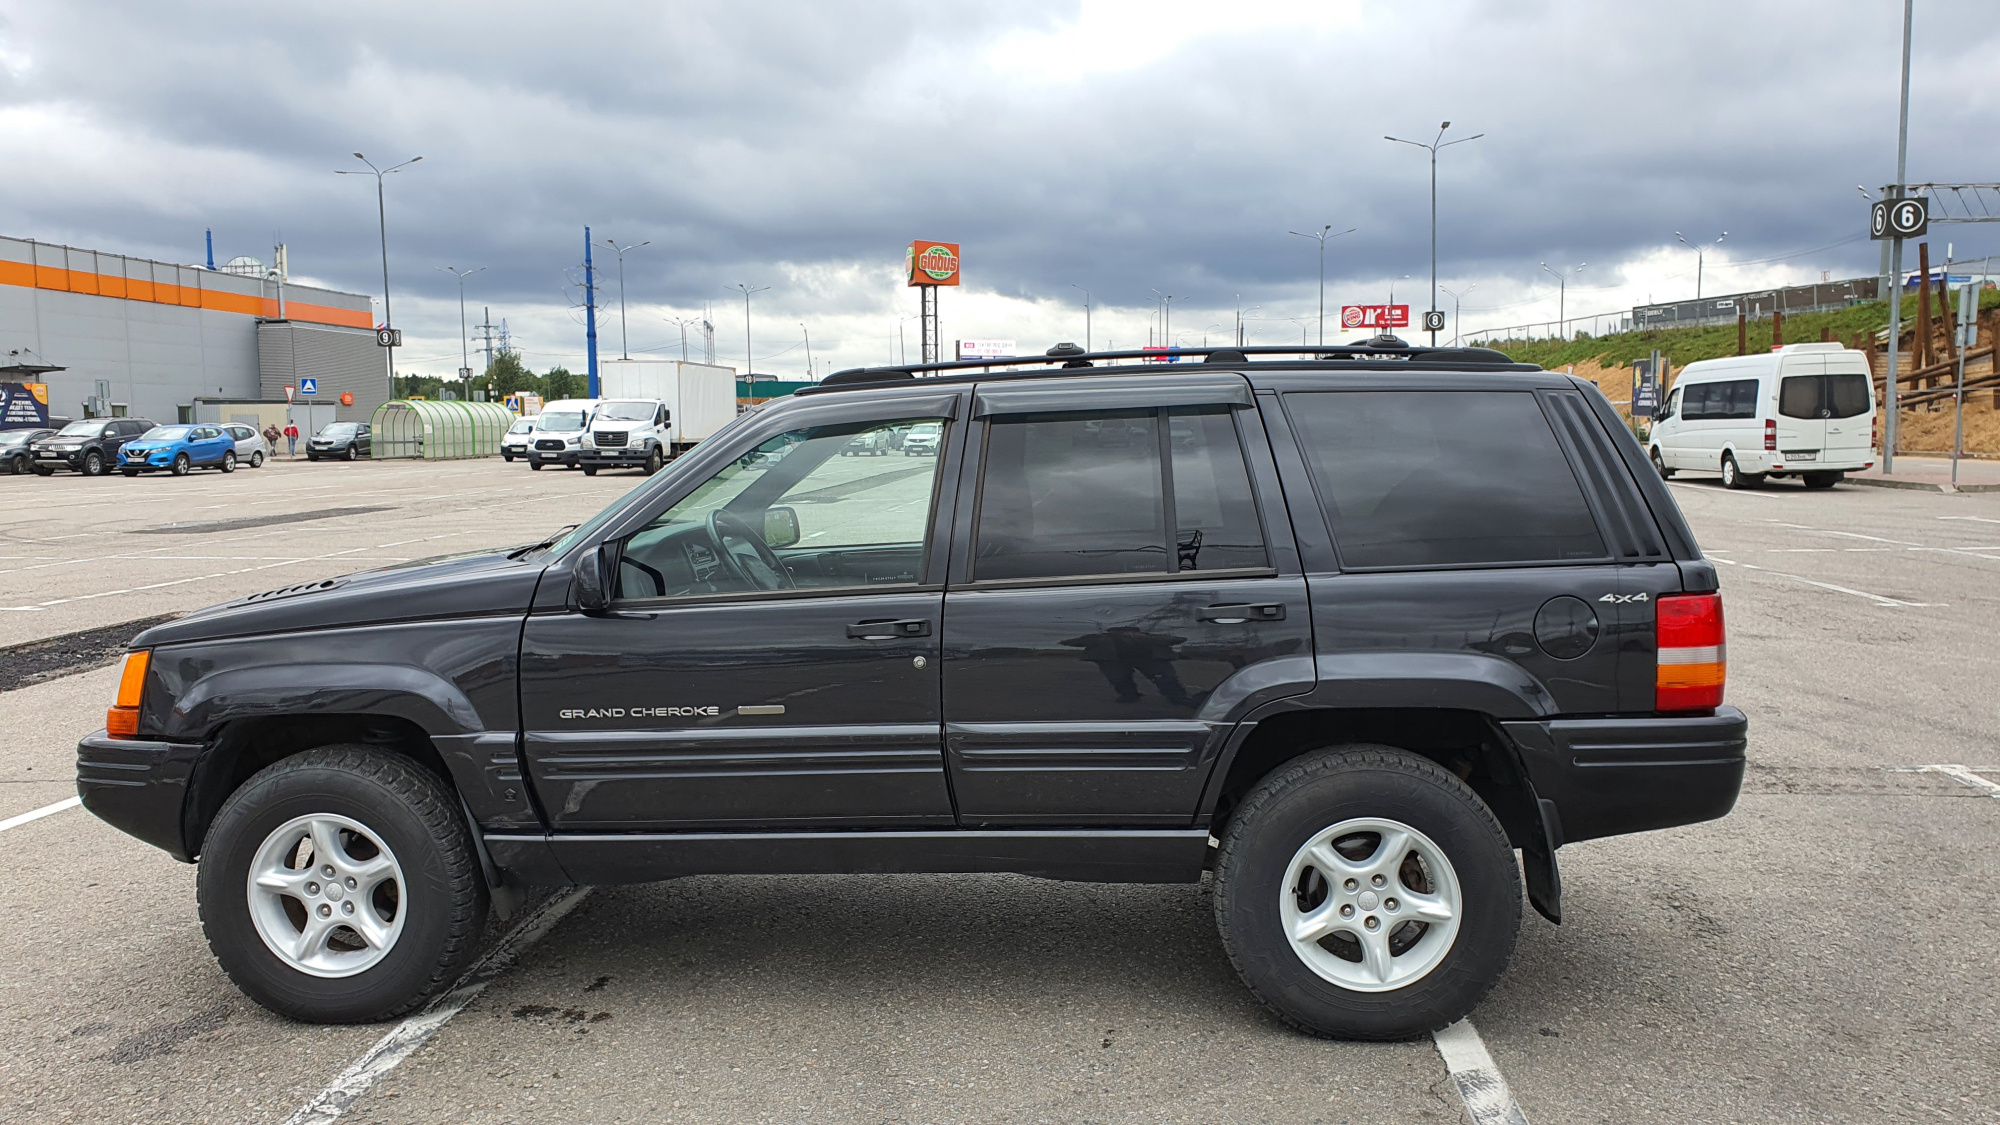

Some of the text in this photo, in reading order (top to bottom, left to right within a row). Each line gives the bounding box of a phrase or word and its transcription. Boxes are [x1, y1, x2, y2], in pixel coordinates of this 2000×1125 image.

[1876, 209, 1882, 230] 6
[1901, 205, 1914, 227] 6
[1432, 315, 1439, 326] 8
[382, 332, 389, 343] 9
[559, 706, 719, 719] GRAND CHEROKE
